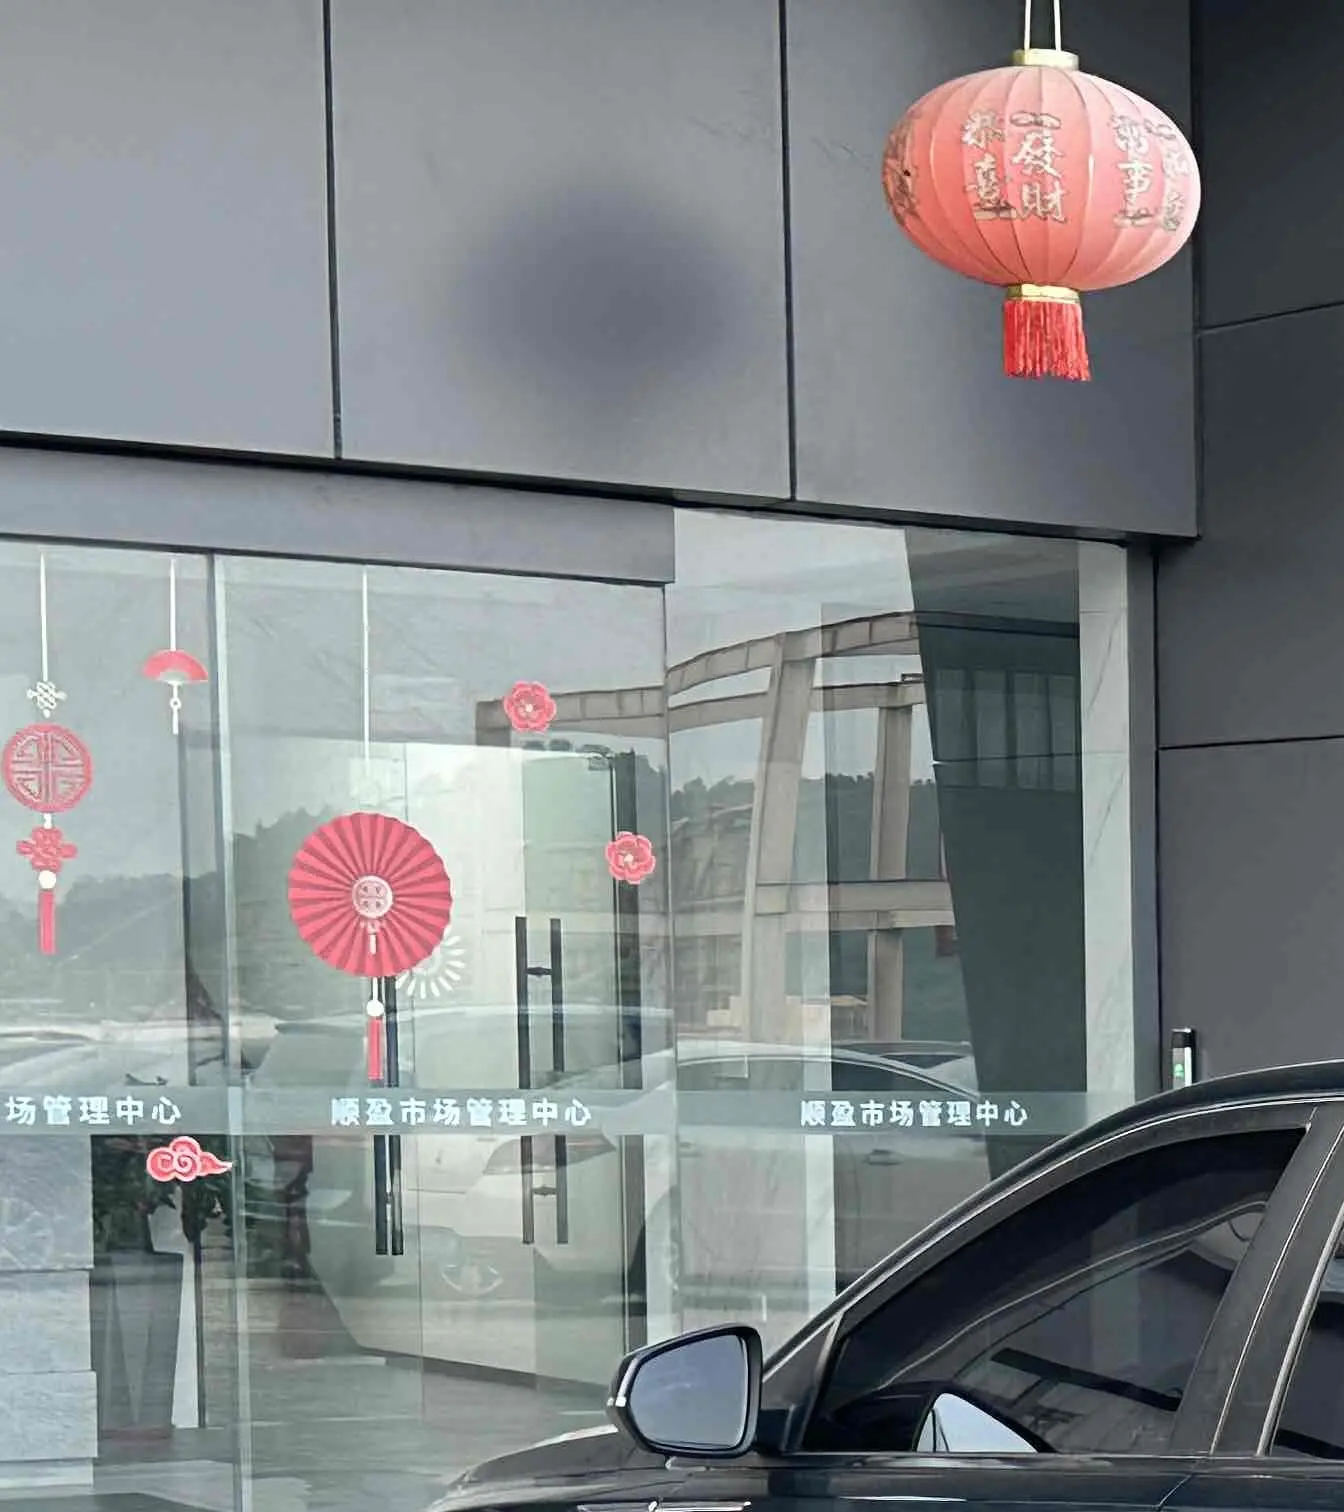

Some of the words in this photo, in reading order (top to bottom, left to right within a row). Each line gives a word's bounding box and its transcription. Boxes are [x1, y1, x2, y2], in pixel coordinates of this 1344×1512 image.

[5, 1095, 183, 1127] 场管理中心
[330, 1097, 592, 1129] 顺盈市场管理中心
[800, 1100, 1029, 1128] 顺盈市场管理中心
